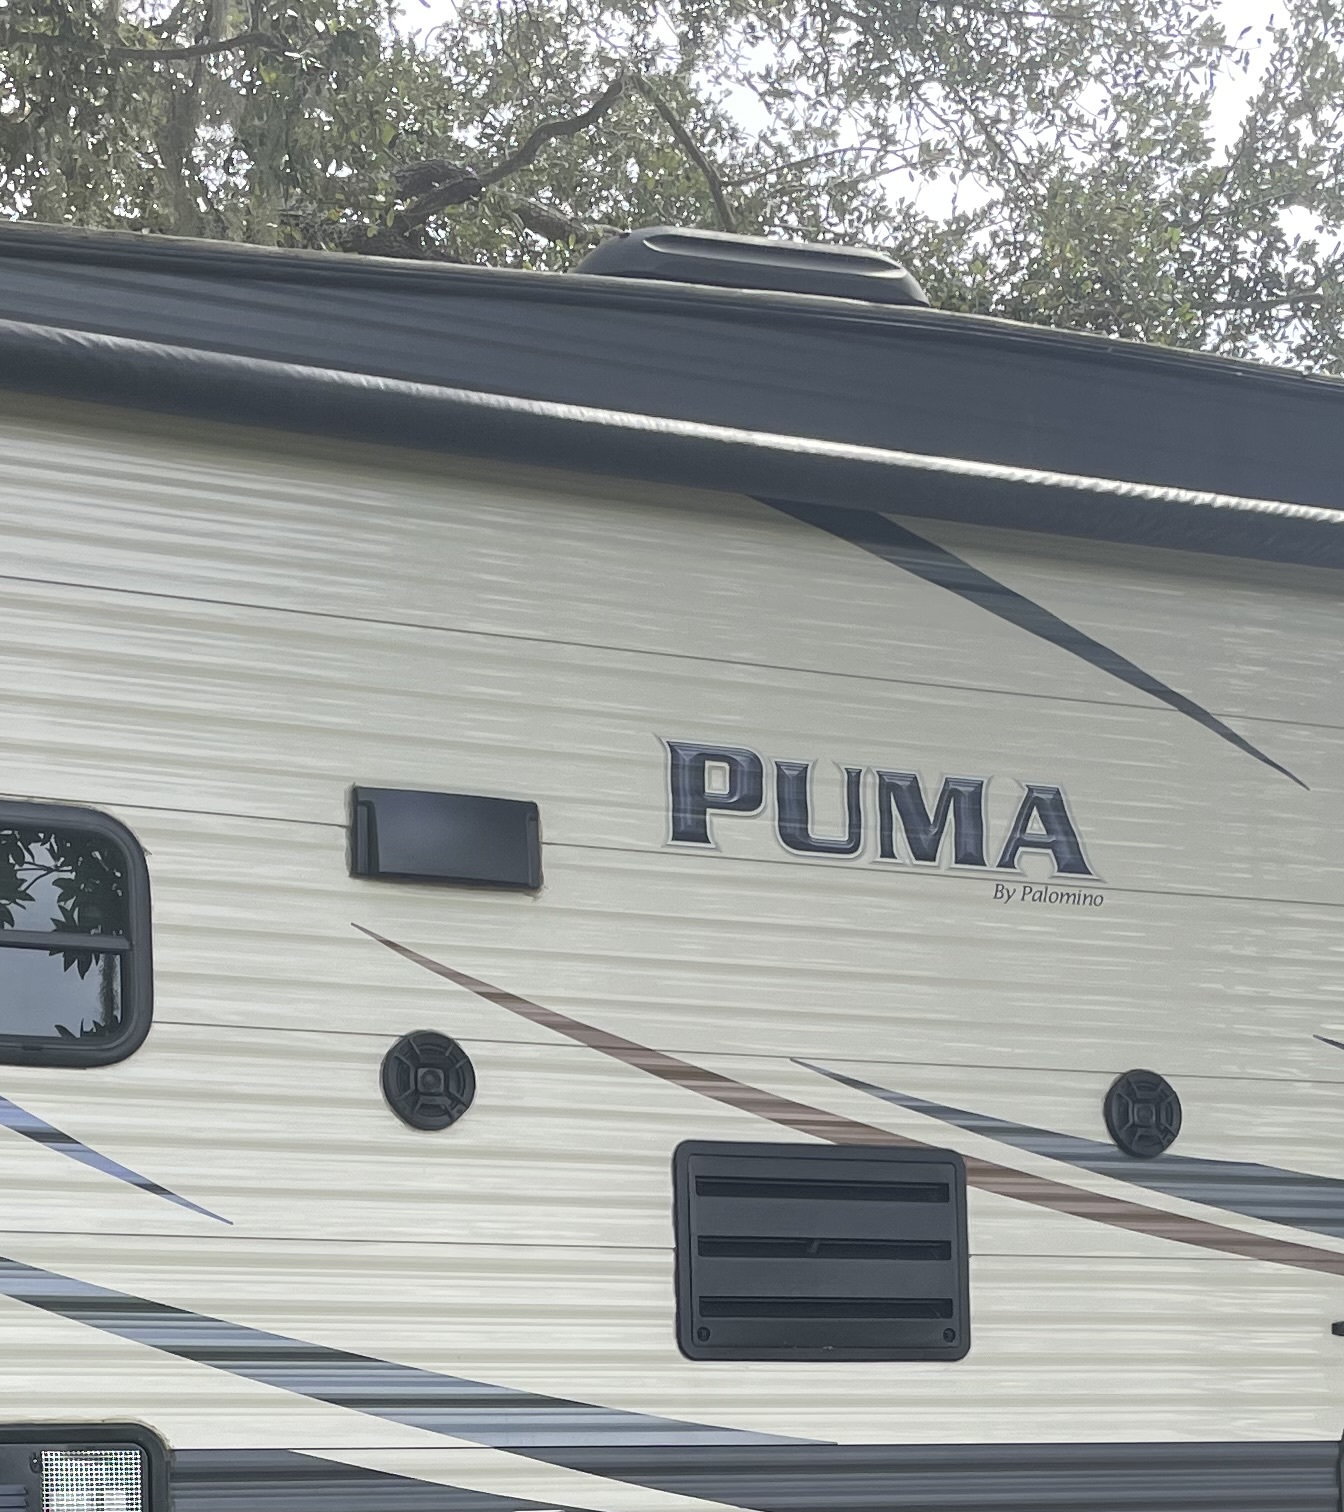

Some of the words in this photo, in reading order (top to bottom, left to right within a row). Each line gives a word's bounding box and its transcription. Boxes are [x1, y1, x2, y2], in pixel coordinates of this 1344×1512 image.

[658, 736, 1102, 880] PUMA
[992, 882, 1017, 903] By
[1020, 885, 1105, 907] Palomino
